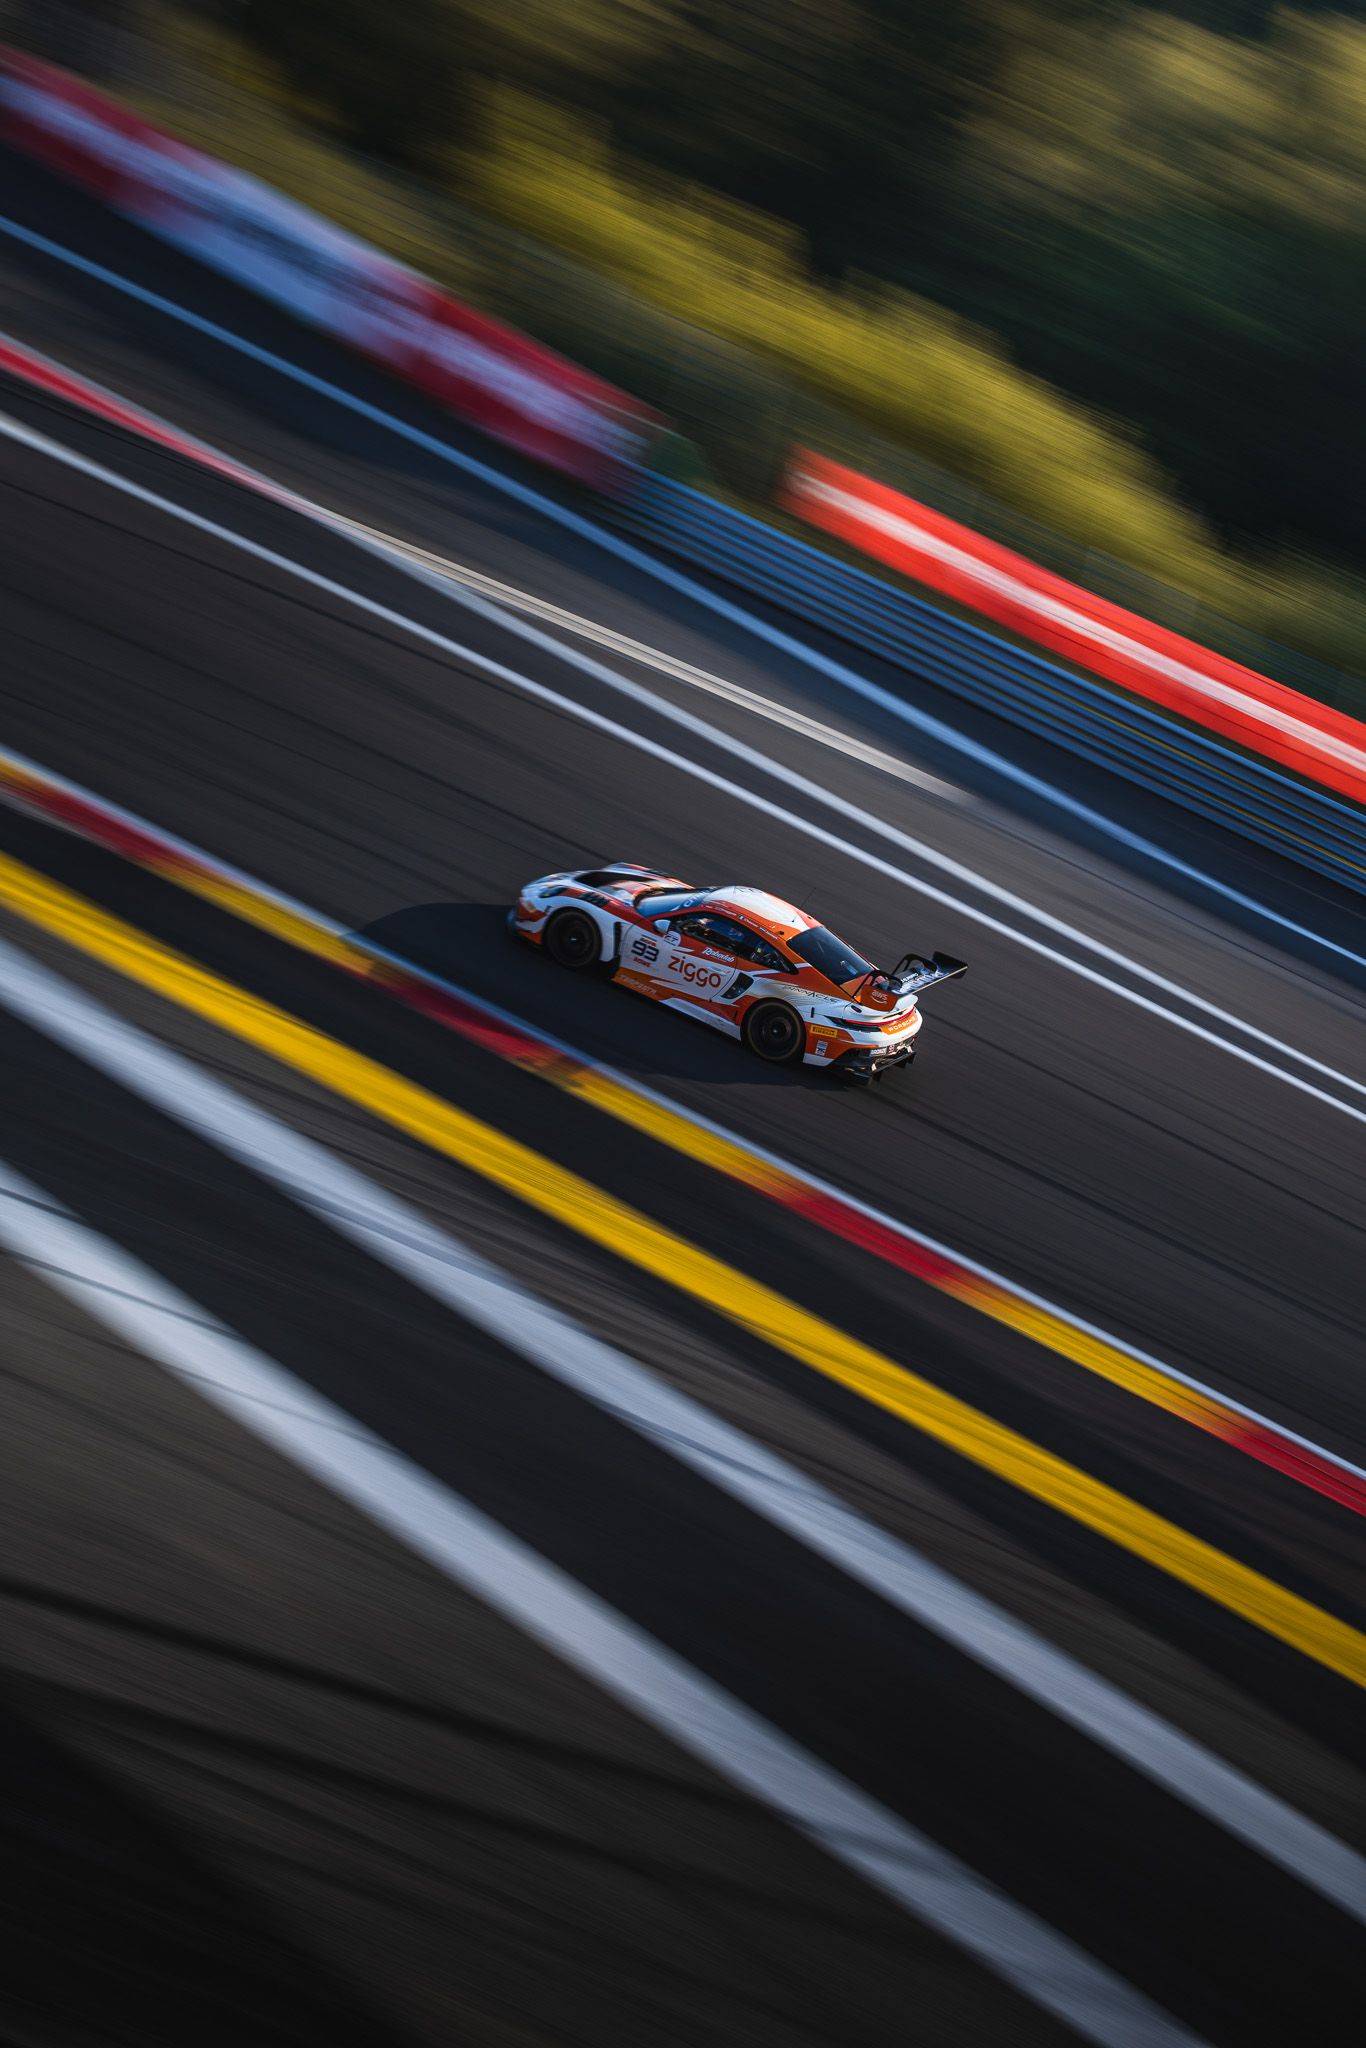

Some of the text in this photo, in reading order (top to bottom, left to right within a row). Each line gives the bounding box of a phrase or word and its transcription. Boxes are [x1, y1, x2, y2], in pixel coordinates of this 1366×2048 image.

[631, 940, 660, 962] 93
[667, 955, 722, 989] ziggo
[887, 1016, 916, 1033] PORSCHE
